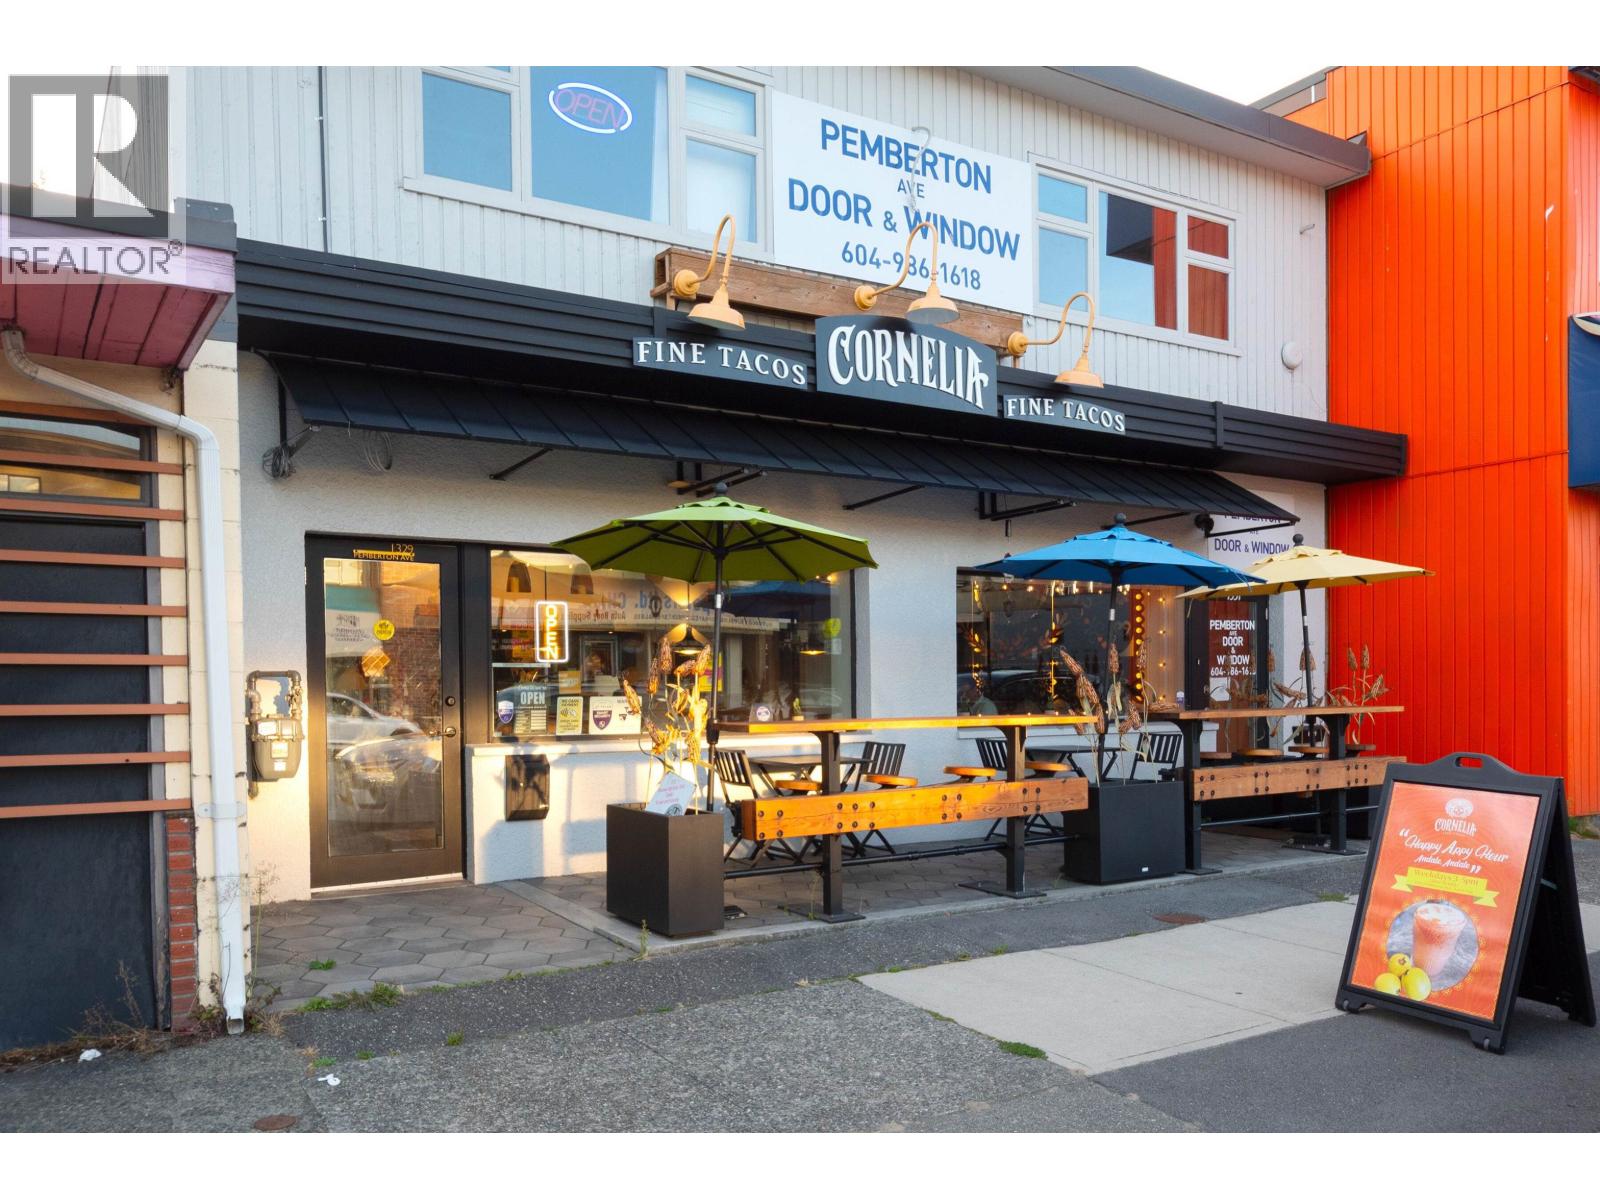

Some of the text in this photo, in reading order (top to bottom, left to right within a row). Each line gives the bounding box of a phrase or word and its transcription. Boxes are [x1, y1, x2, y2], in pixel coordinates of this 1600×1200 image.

[554, 89, 625, 129] OPEN
[821, 118, 991, 194] PEMBERTON
[897, 178, 925, 199] AVE
[788, 178, 1020, 261] DOOR & WINDOW
[841, 241, 981, 290] 604-9861618
[637, 340, 806, 386] FINE TACOS
[827, 323, 989, 410] CORNELIA
[1006, 397, 1126, 432] FINE TACOS
[391, 544, 414, 553] 1329
[1214, 538, 1242, 552] DOOR
[1244, 544, 1250, 553] &
[545, 605, 559, 660] OPEN
[1210, 620, 1255, 630] PEMBERTON
[1222, 637, 1244, 646] DOOR
[1217, 655, 1250, 665] WDOW
[520, 692, 545, 705] OPEN
[1434, 818, 1477, 837] CORNELIA
[1442, 840, 1473, 860] Appy
[1475, 845, 1509, 862] Hour
